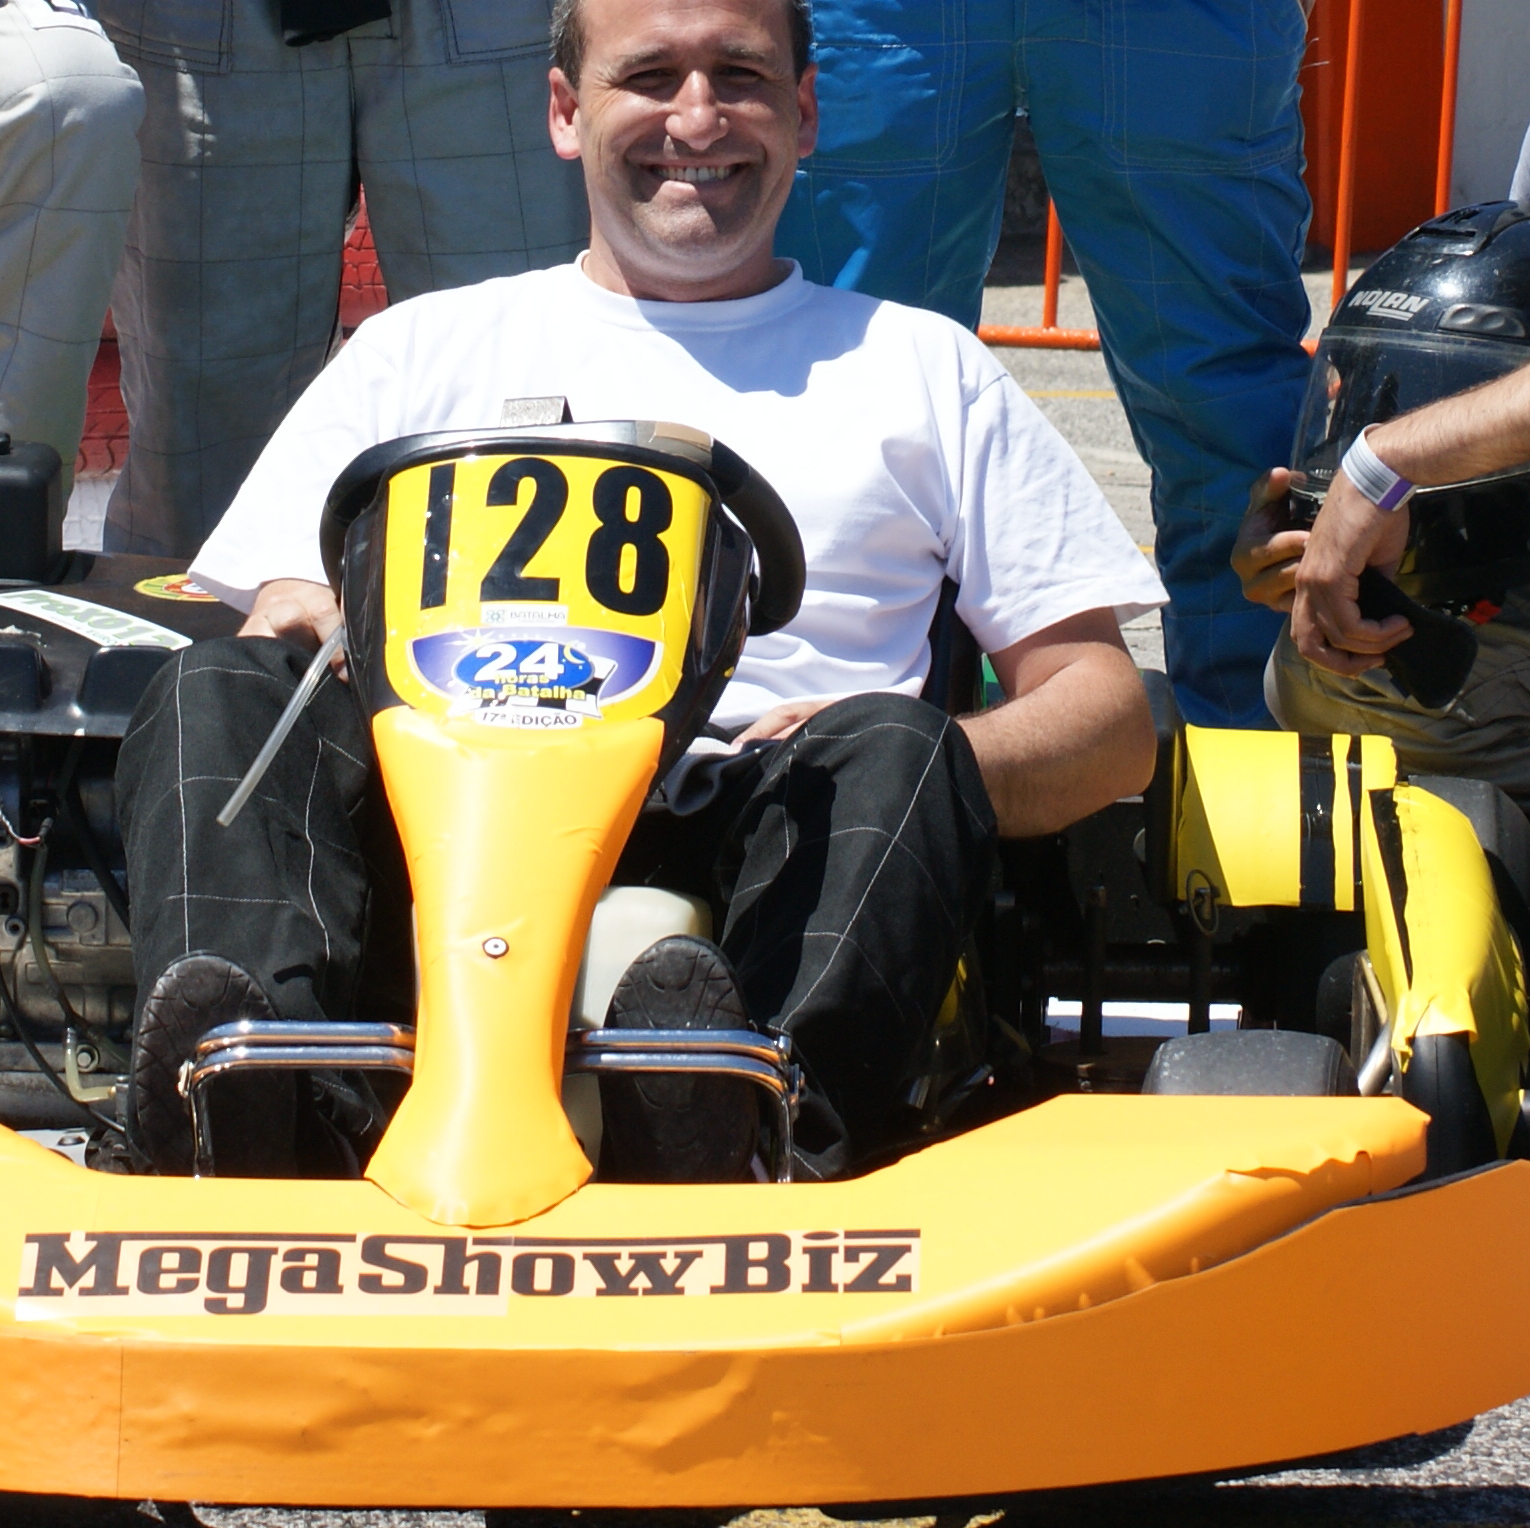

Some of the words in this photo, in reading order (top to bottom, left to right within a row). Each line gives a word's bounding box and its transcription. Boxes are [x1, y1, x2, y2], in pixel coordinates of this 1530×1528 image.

[1348, 290, 1430, 322] NOLAN
[420, 457, 673, 616] 128
[510, 609, 566, 621] BATALHA
[473, 642, 565, 682] 24
[499, 682, 587, 702] Batalha
